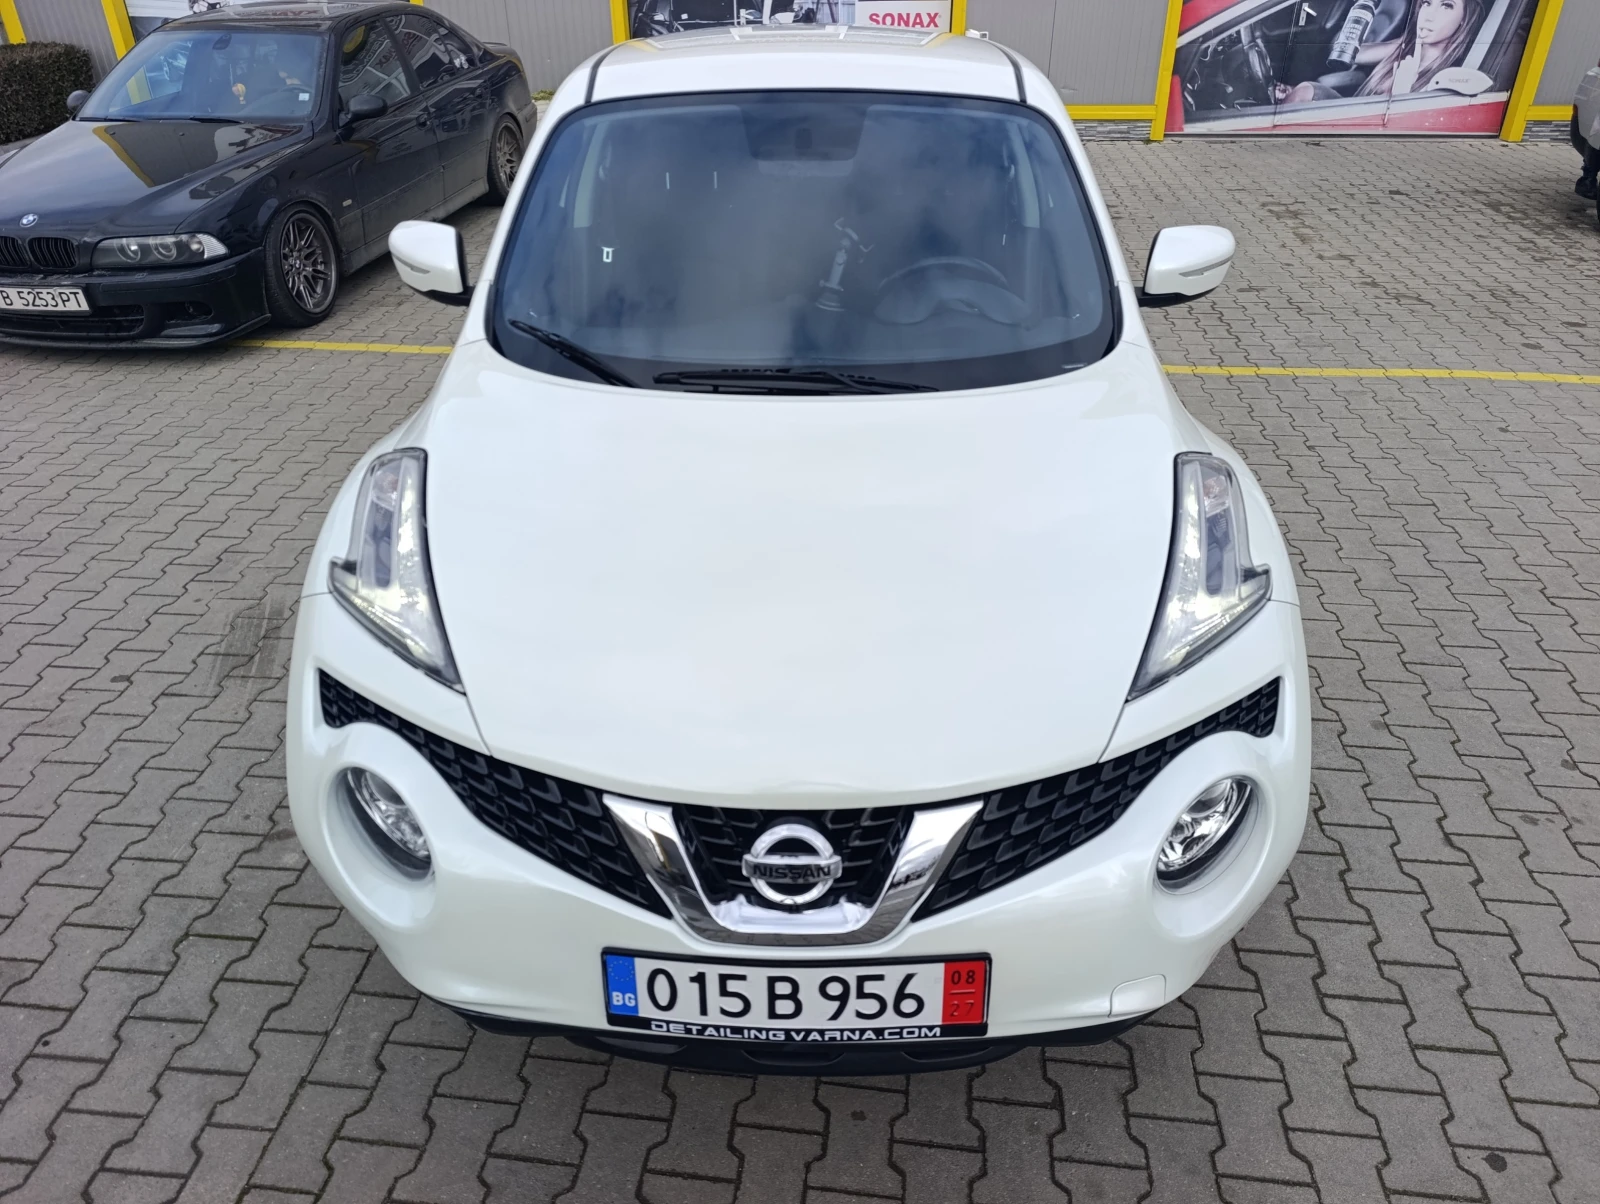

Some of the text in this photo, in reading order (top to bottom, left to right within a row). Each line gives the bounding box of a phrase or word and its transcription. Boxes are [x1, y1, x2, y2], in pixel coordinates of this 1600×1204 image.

[868, 12, 940, 28] SONAX
[0, 290, 13, 306] B
[753, 865, 831, 879] NISSAN
[951, 969, 976, 985] 08
[612, 991, 636, 1007] BG
